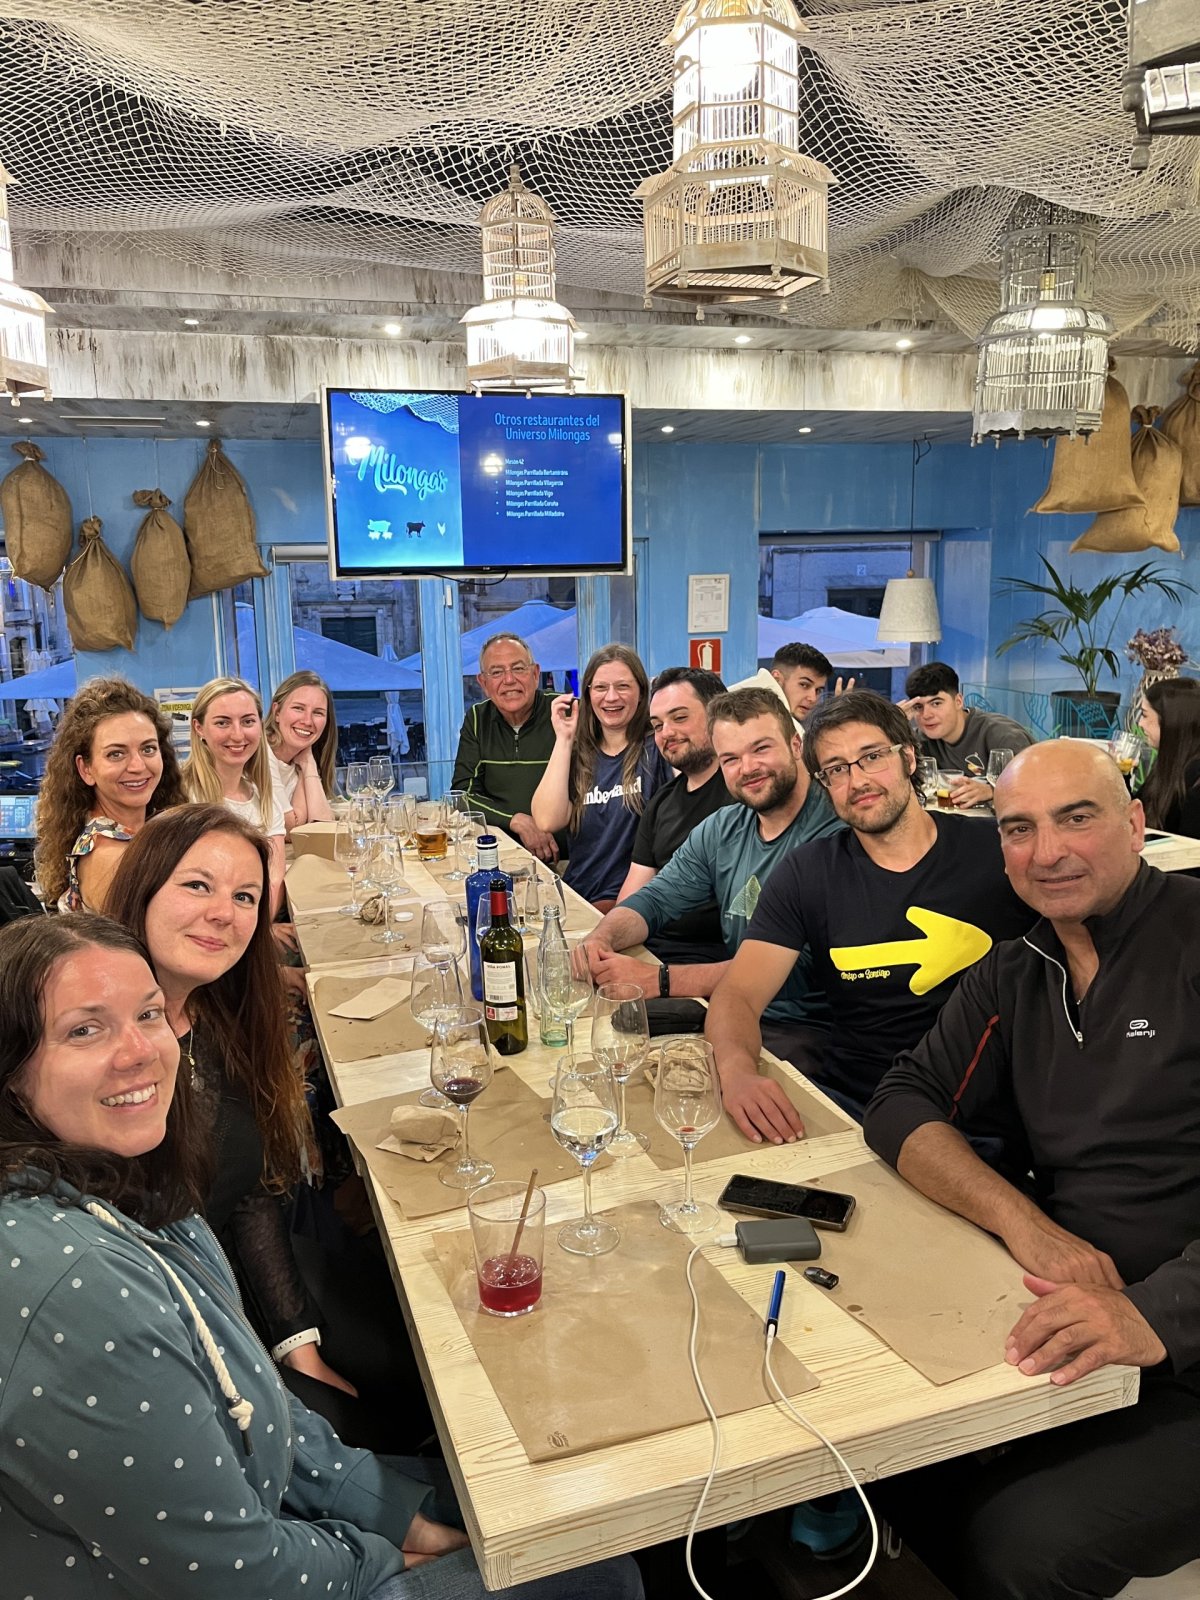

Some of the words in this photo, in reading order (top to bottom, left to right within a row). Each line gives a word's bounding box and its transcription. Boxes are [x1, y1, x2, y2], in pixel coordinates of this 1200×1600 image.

[494, 412, 521, 425] Otros
[523, 414, 584, 426] restaurantes
[585, 414, 600, 426] del
[505, 427, 547, 440] Universo
[548, 427, 591, 444] Milongas
[347, 443, 449, 500] Milongas
[505, 469, 523, 477] Milongas
[505, 479, 523, 487] Milongas
[506, 490, 524, 498] Milongas
[543, 490, 554, 498] Vigo
[506, 500, 524, 508] Milongas
